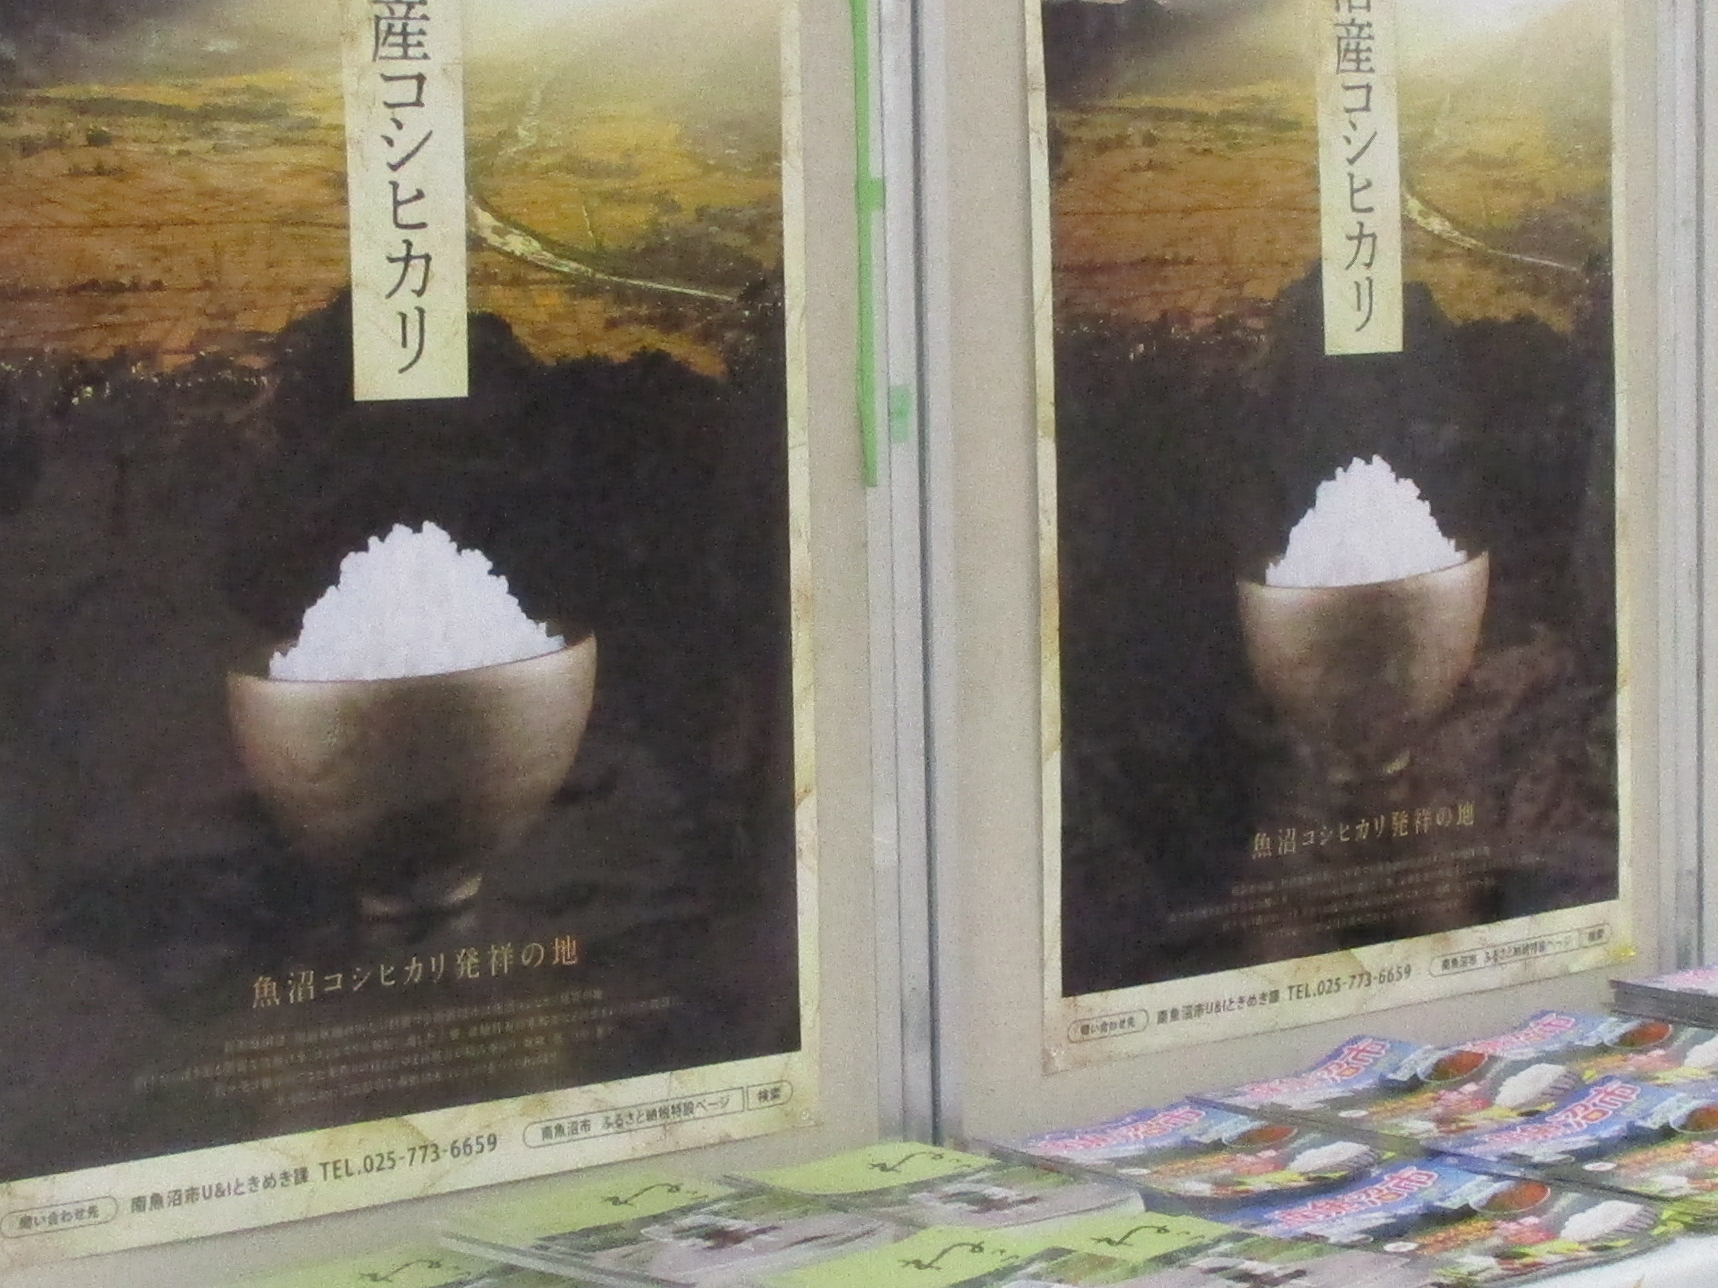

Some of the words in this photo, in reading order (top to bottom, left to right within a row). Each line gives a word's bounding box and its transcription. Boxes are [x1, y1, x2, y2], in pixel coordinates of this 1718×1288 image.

[1251, 802, 1477, 859] 魚沼コシヒカリ発祥の地
[251, 934, 580, 1009] 魚沼コシヒカリ発祥の地
[1286, 963, 1412, 1002] TEL.025-773-6659
[540, 1118, 592, 1142] 南魚沼市
[319, 1132, 499, 1183] TEL.025-773-6659
